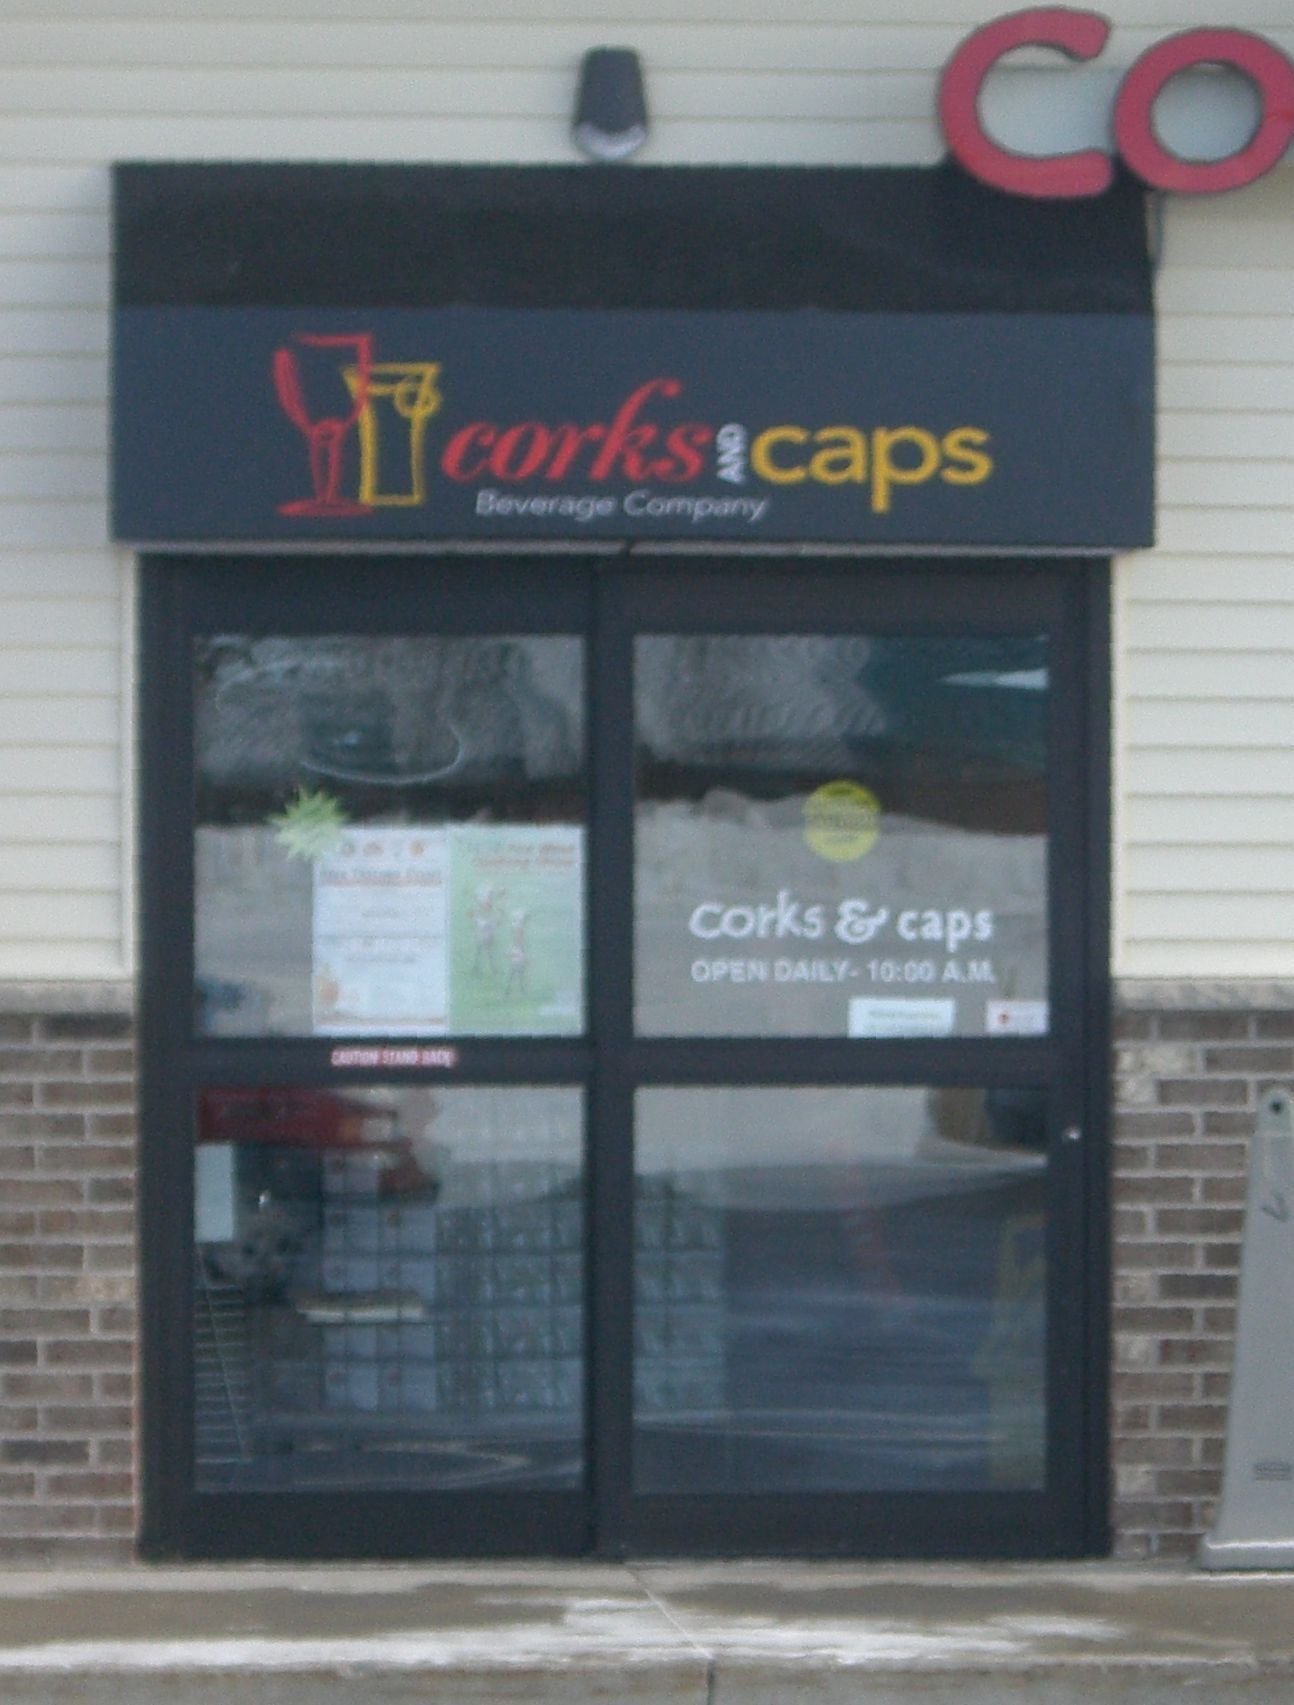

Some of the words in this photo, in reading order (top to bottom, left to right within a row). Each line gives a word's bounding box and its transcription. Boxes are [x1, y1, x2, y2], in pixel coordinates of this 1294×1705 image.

[442, 378, 713, 484] corks
[716, 422, 746, 484] AND
[751, 425, 994, 513] caps
[475, 488, 615, 523] Beverage
[623, 488, 770, 523] Company
[688, 888, 826, 939] corks
[834, 898, 889, 944] &
[896, 908, 995, 952] caps
[690, 959, 767, 983] OPEN
[866, 959, 936, 983] 10:00
